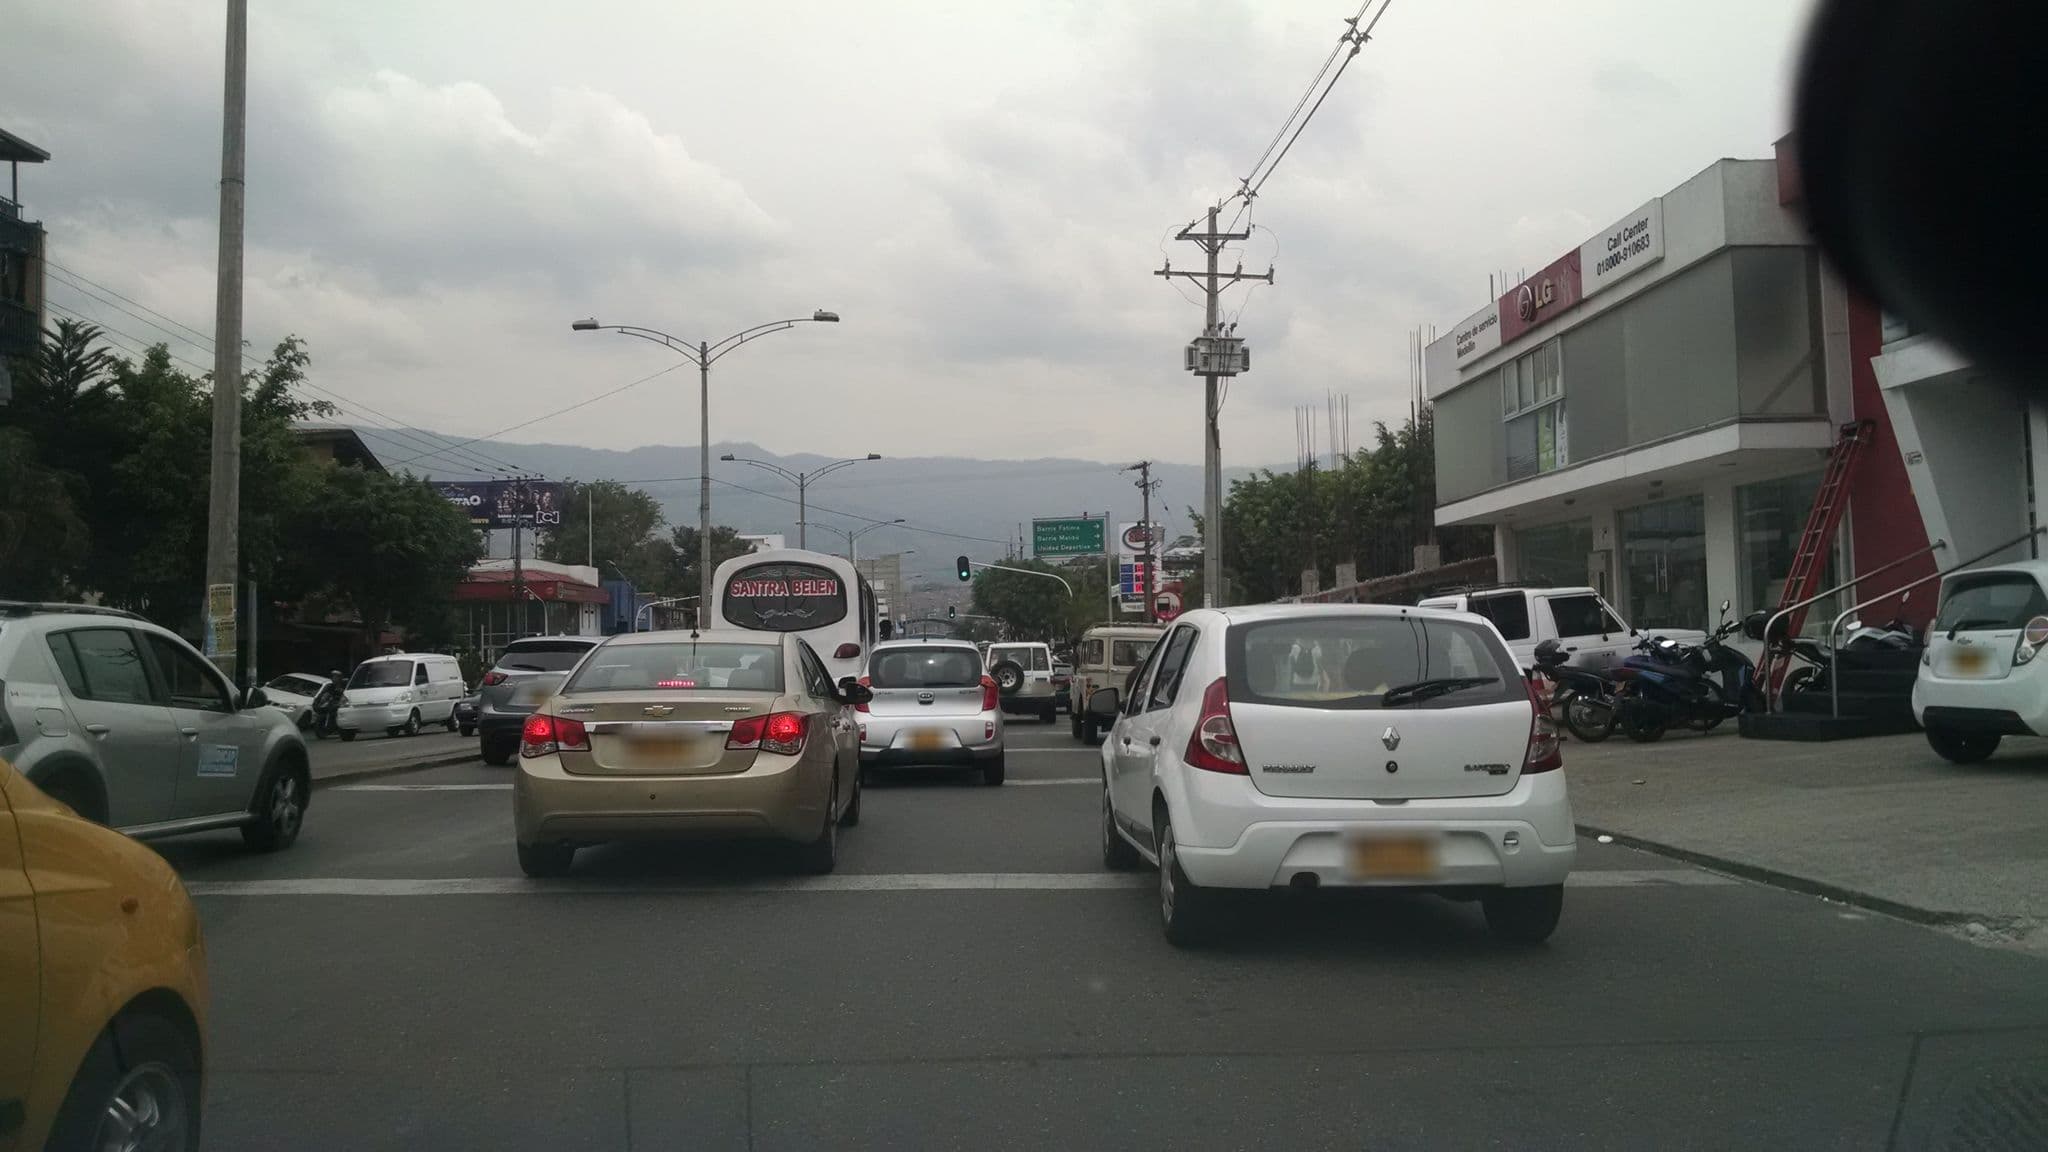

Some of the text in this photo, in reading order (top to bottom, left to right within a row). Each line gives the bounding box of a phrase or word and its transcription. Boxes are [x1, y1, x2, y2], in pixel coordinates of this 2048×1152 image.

[1608, 217, 1649, 251] Call Center
[1596, 233, 1650, 276] 018000-910683
[1535, 278, 1553, 309] LG
[1456, 313, 1498, 346] Centro de servicio
[731, 580, 837, 597] SANTRA BELEN
